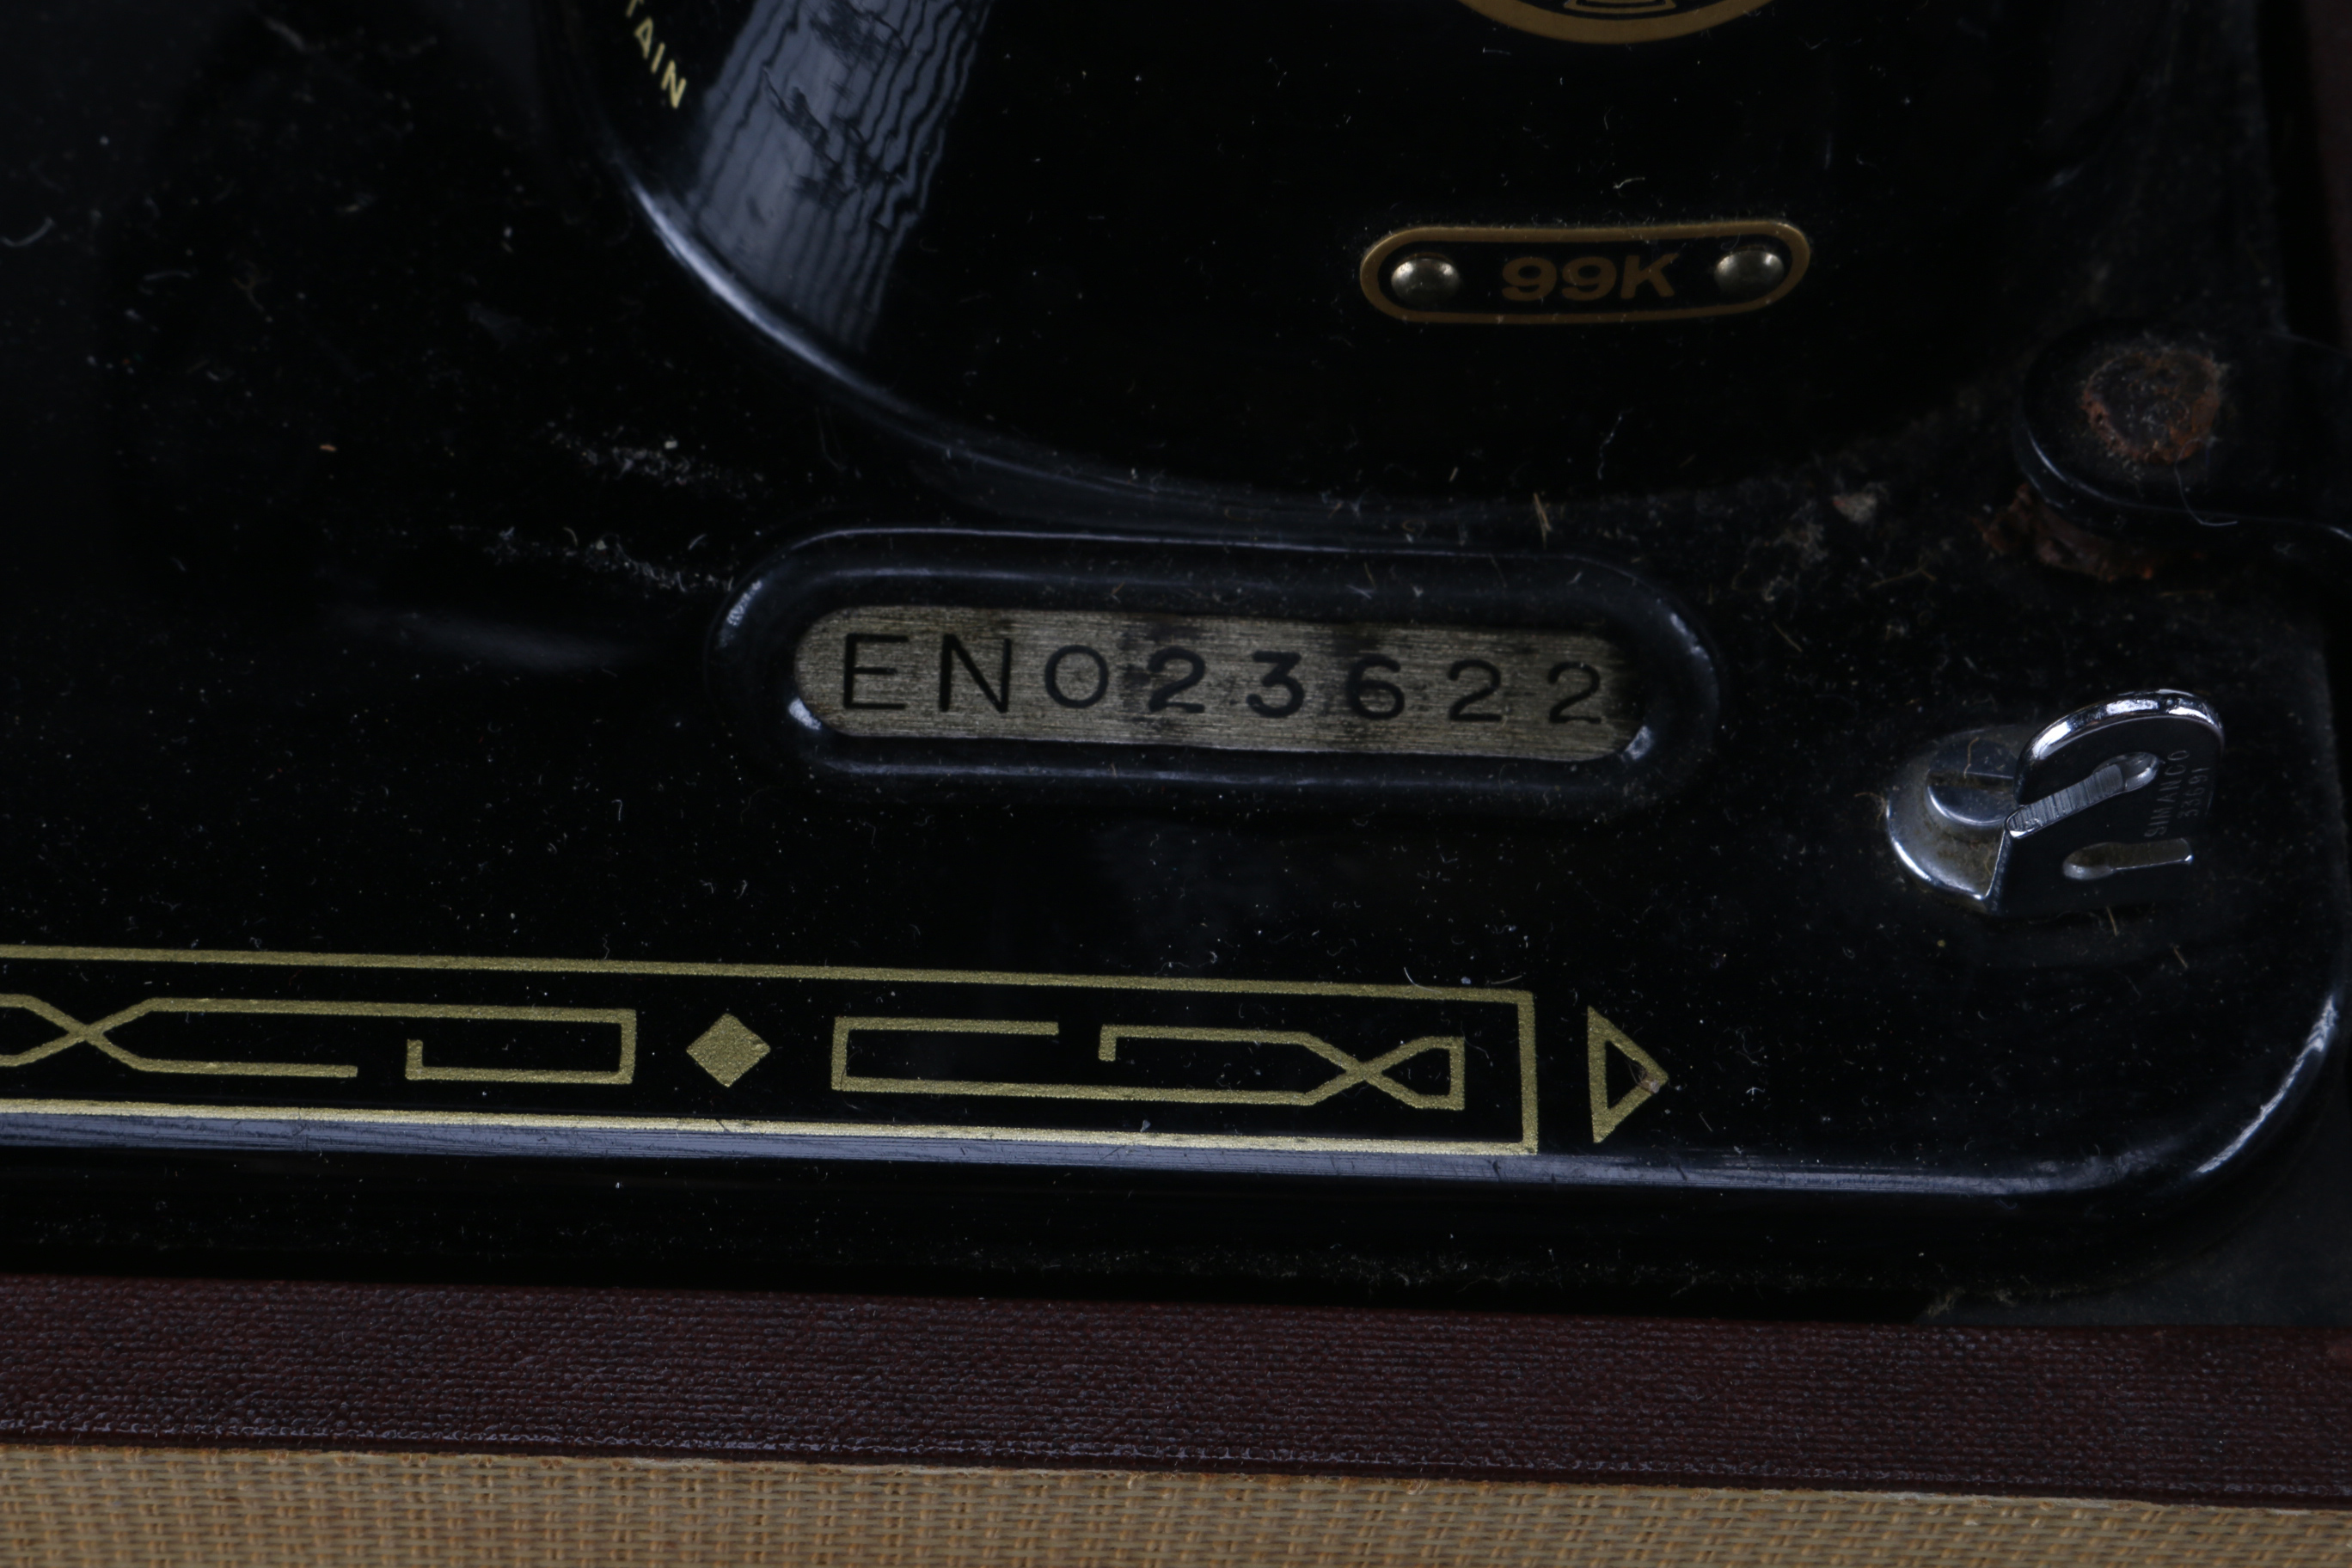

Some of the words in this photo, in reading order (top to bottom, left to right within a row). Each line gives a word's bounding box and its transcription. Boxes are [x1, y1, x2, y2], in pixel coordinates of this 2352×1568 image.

[1501, 254, 1680, 302] 99K
[2143, 749, 2190, 838] SIMANCO
[2177, 766, 2211, 819] 33691
